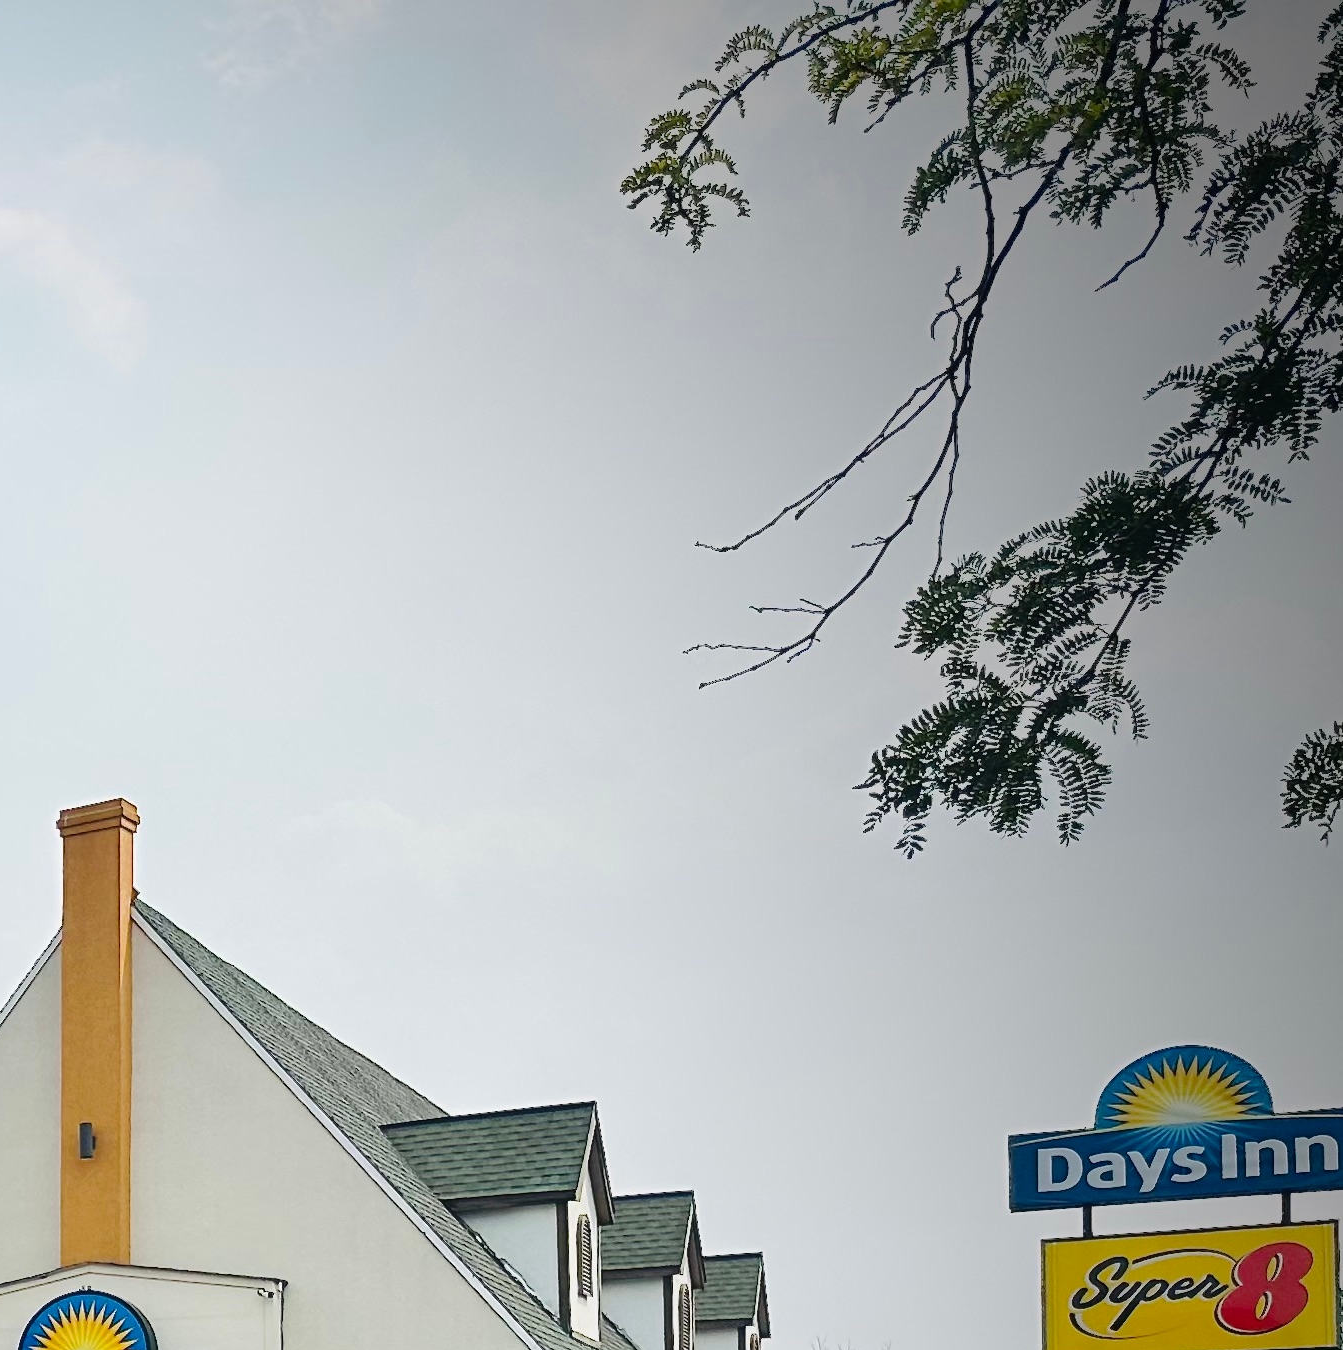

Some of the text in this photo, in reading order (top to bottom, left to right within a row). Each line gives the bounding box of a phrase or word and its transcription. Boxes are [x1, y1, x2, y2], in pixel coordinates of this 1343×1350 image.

[1037, 1133, 1340, 1194] Days Inn
[1070, 1241, 1315, 1336] Super 8
